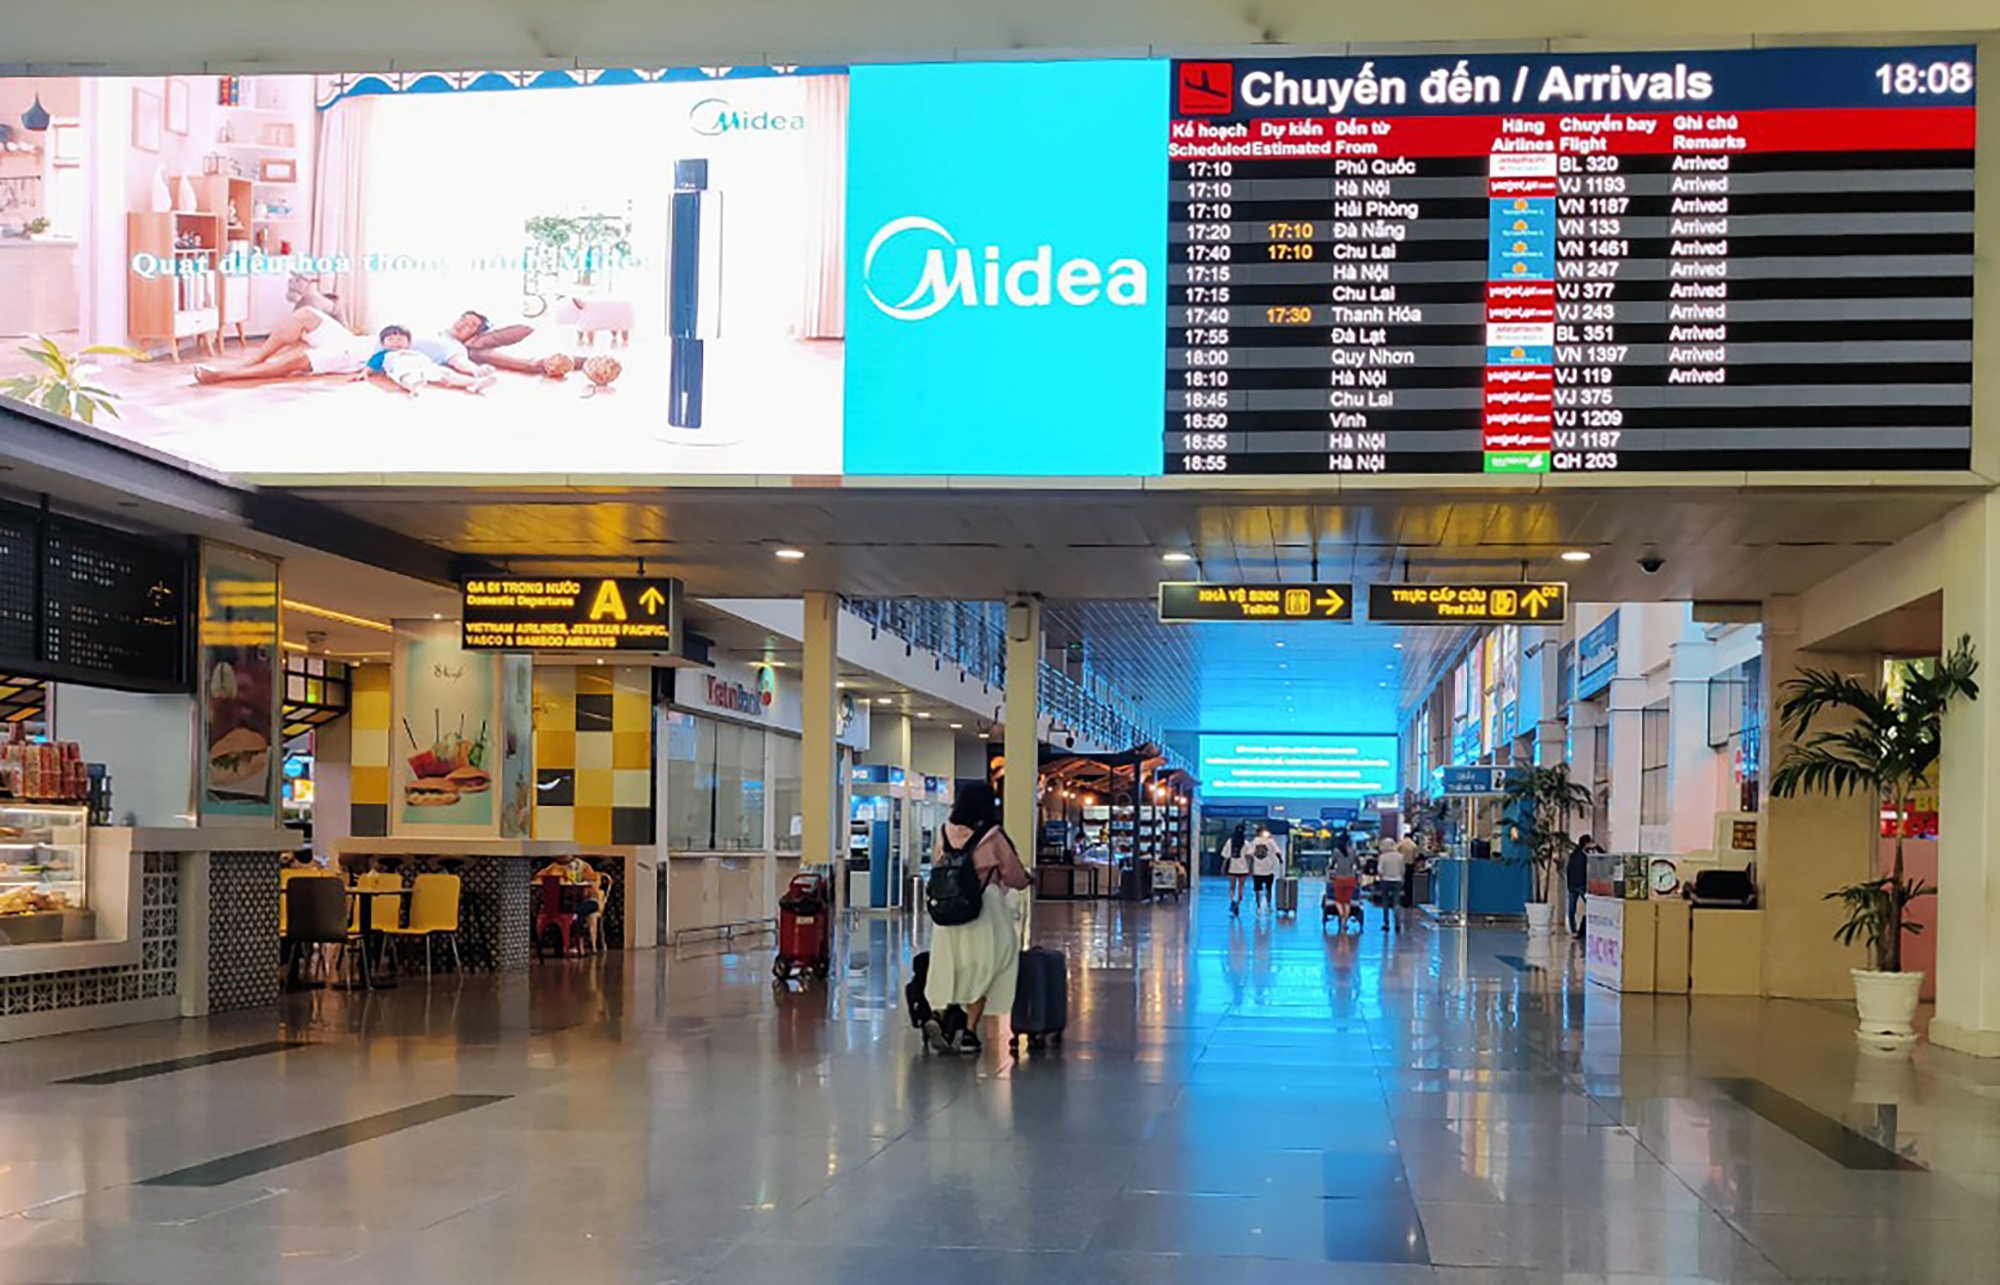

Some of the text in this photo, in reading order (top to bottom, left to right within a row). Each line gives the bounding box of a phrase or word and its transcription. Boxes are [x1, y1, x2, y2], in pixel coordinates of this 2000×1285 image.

[1240, 60, 1713, 113] Chuyến đến / Arrivals
[1876, 62, 1973, 94] 18:08
[698, 104, 804, 134] Midea
[1626, 117, 1657, 134] bay
[1673, 115, 1738, 131] Ghi chú
[1198, 122, 1247, 140] hoạch
[1168, 142, 1250, 157] Scheduled
[1252, 141, 1331, 155] Estimated
[1335, 140, 1377, 154] From
[1491, 138, 1553, 152] Airlines
[1560, 137, 1607, 154] Flight
[1673, 135, 1746, 150] Remarks
[1188, 161, 1232, 177] 17:10
[1559, 156, 1583, 172] BL
[1586, 155, 1619, 172] 320
[1672, 155, 1729, 171] Arrived
[1187, 182, 1232, 198] 17:10
[1558, 177, 1581, 194] VJ
[1586, 176, 1626, 193] 1193
[1671, 175, 1729, 193] Arrived
[1187, 203, 1232, 219] 17:10
[1558, 198, 1585, 214] VN
[1589, 197, 1629, 214] 1187
[1671, 197, 1728, 213] Arrived
[1187, 223, 1231, 240] 17:20
[1268, 222, 1313, 239] 17:10
[1557, 219, 1585, 236] VN
[1589, 218, 1621, 236] 133
[1670, 218, 1728, 235] Arrived
[1187, 245, 1231, 261] 17:40
[1268, 244, 1313, 259] 17:10
[1333, 243, 1396, 259] Chu Lai
[1557, 240, 1584, 257] VN
[1670, 240, 1727, 256] Arrived
[876, 228, 1148, 314] Midea
[1186, 265, 1231, 282] 17:15
[1556, 261, 1584, 278] VN
[1586, 260, 1620, 278] 247
[1670, 260, 1727, 278] Arrived
[1186, 287, 1230, 303] 17:15
[1332, 285, 1395, 301] Chu Lai
[1556, 283, 1579, 299] VJ
[1583, 282, 1615, 299] 377
[1670, 282, 1726, 298] Arrived
[1186, 307, 1230, 324] 17:40
[1267, 307, 1312, 323] 17:30
[1331, 306, 1384, 323] Thanh
[1556, 304, 1579, 321] VJ
[1582, 303, 1615, 321] 243
[1669, 303, 1726, 320] Arrived
[1185, 329, 1229, 345] 17:55
[1556, 325, 1580, 342] BL
[1583, 325, 1613, 341] 351
[1669, 324, 1726, 341] Arrived
[1185, 349, 1229, 366] 18:00
[1331, 348, 1366, 368] Quy
[1555, 346, 1582, 363] VN
[1587, 345, 1628, 363] 1397
[1668, 345, 1726, 363] Arrived
[1185, 371, 1228, 387] 18:10
[1554, 368, 1578, 384] VJ
[1582, 367, 1612, 384] 119
[1668, 367, 1725, 383] Arrived
[1184, 391, 1228, 408] 18:45
[1330, 390, 1394, 408] Chu Lai
[1553, 388, 1577, 406] VJ
[1580, 388, 1613, 405] 375
[1184, 413, 1228, 429] 18:50
[1329, 412, 1367, 428] Vinh
[1553, 410, 1576, 426] VJ
[1581, 410, 1623, 426] 1209
[1183, 433, 1228, 451] 18:55
[1552, 431, 1576, 448] VJ
[1580, 430, 1621, 448] 1187
[1183, 455, 1227, 471] 18:55
[1553, 452, 1618, 469] QH 203
[502, 582, 544, 594] TRONG
[589, 580, 627, 620] A
